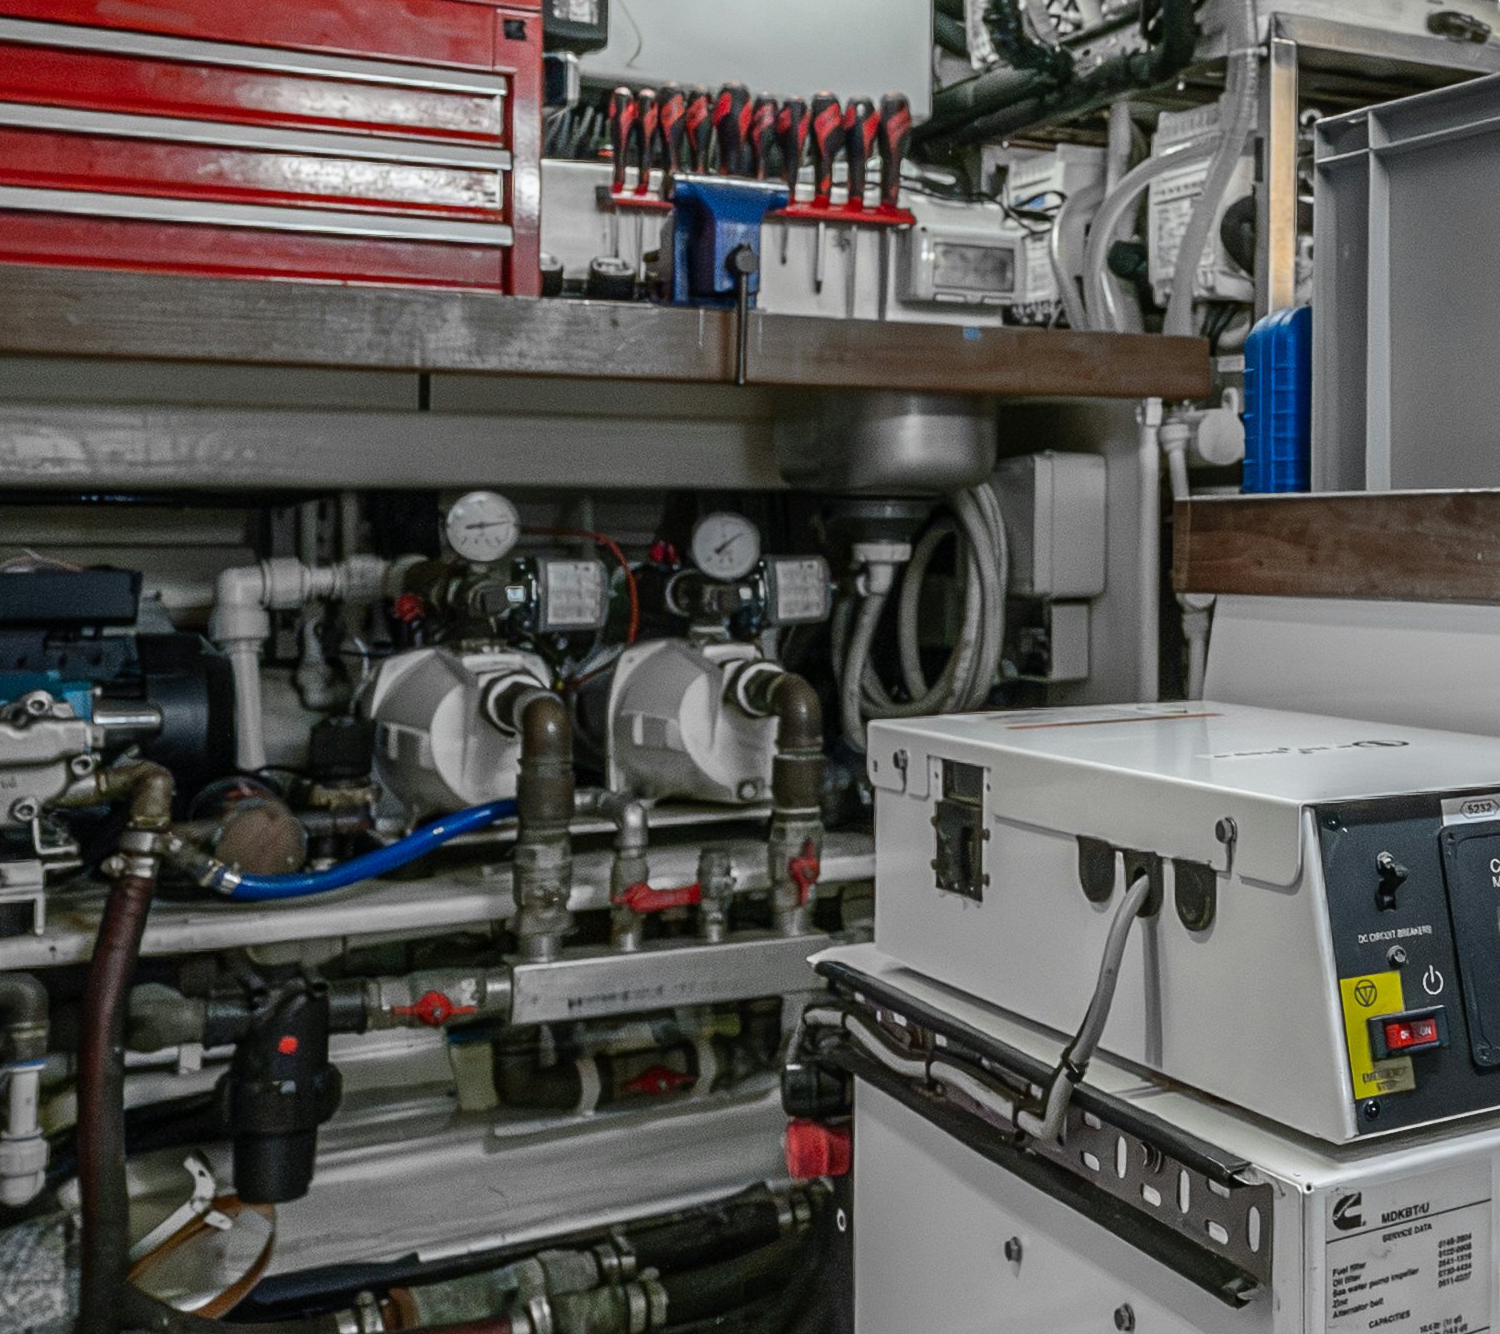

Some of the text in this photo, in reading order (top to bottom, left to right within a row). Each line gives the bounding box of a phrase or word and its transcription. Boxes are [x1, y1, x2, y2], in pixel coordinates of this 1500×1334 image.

[1382, 1221, 1432, 1243] SERVICE DATA
[1368, 1309, 1410, 1329] CAPACITIES
